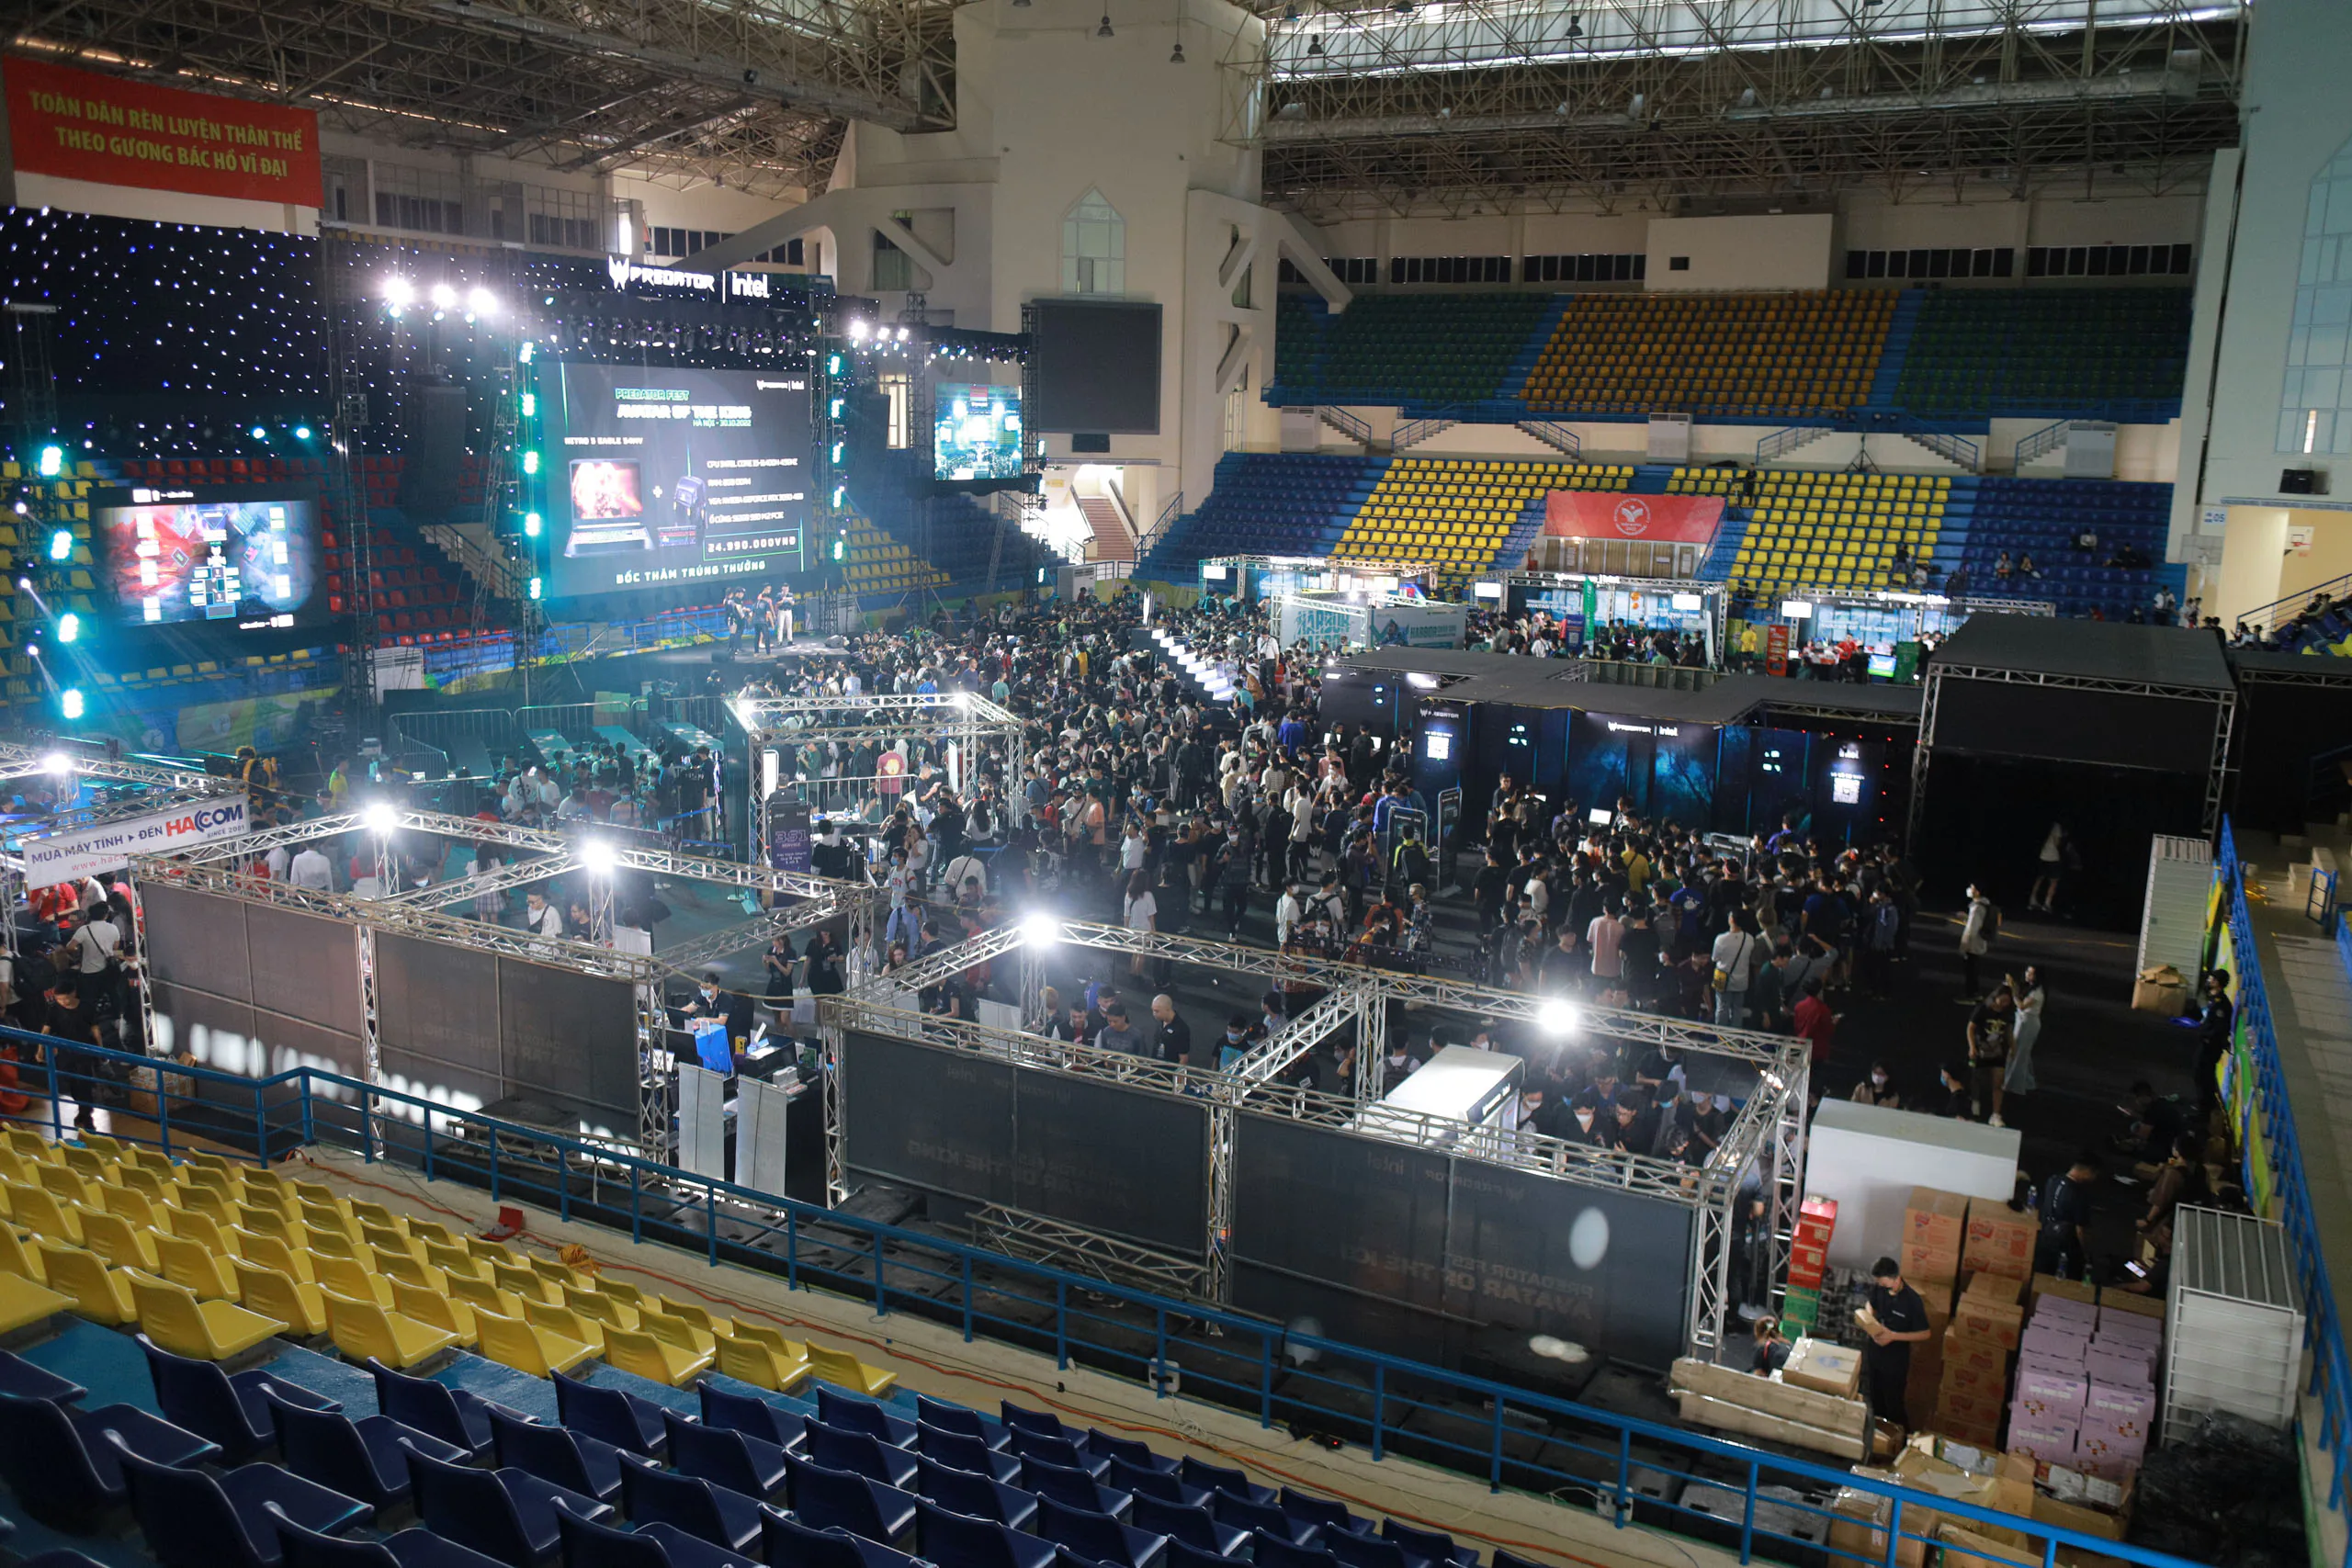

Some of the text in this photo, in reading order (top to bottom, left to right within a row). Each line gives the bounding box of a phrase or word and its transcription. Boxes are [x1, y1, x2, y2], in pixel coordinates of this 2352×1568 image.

[29, 90, 303, 152] TOÀN DÂN RÈN LUYỆN THÂN THỂ
[55, 127, 288, 180] THEO GƯƠNG BÁC HỒ VĨ ĐẠI
[630, 266, 715, 292] PREDATOR
[616, 388, 690, 400] PREDATOR FEST
[616, 560, 765, 584] BỐC THĂM TRÚNG THƯỞNG
[31, 804, 243, 864] MUA MÁY TÍNH ĐẾN HACOM
[207, 829, 226, 839] SINCE
